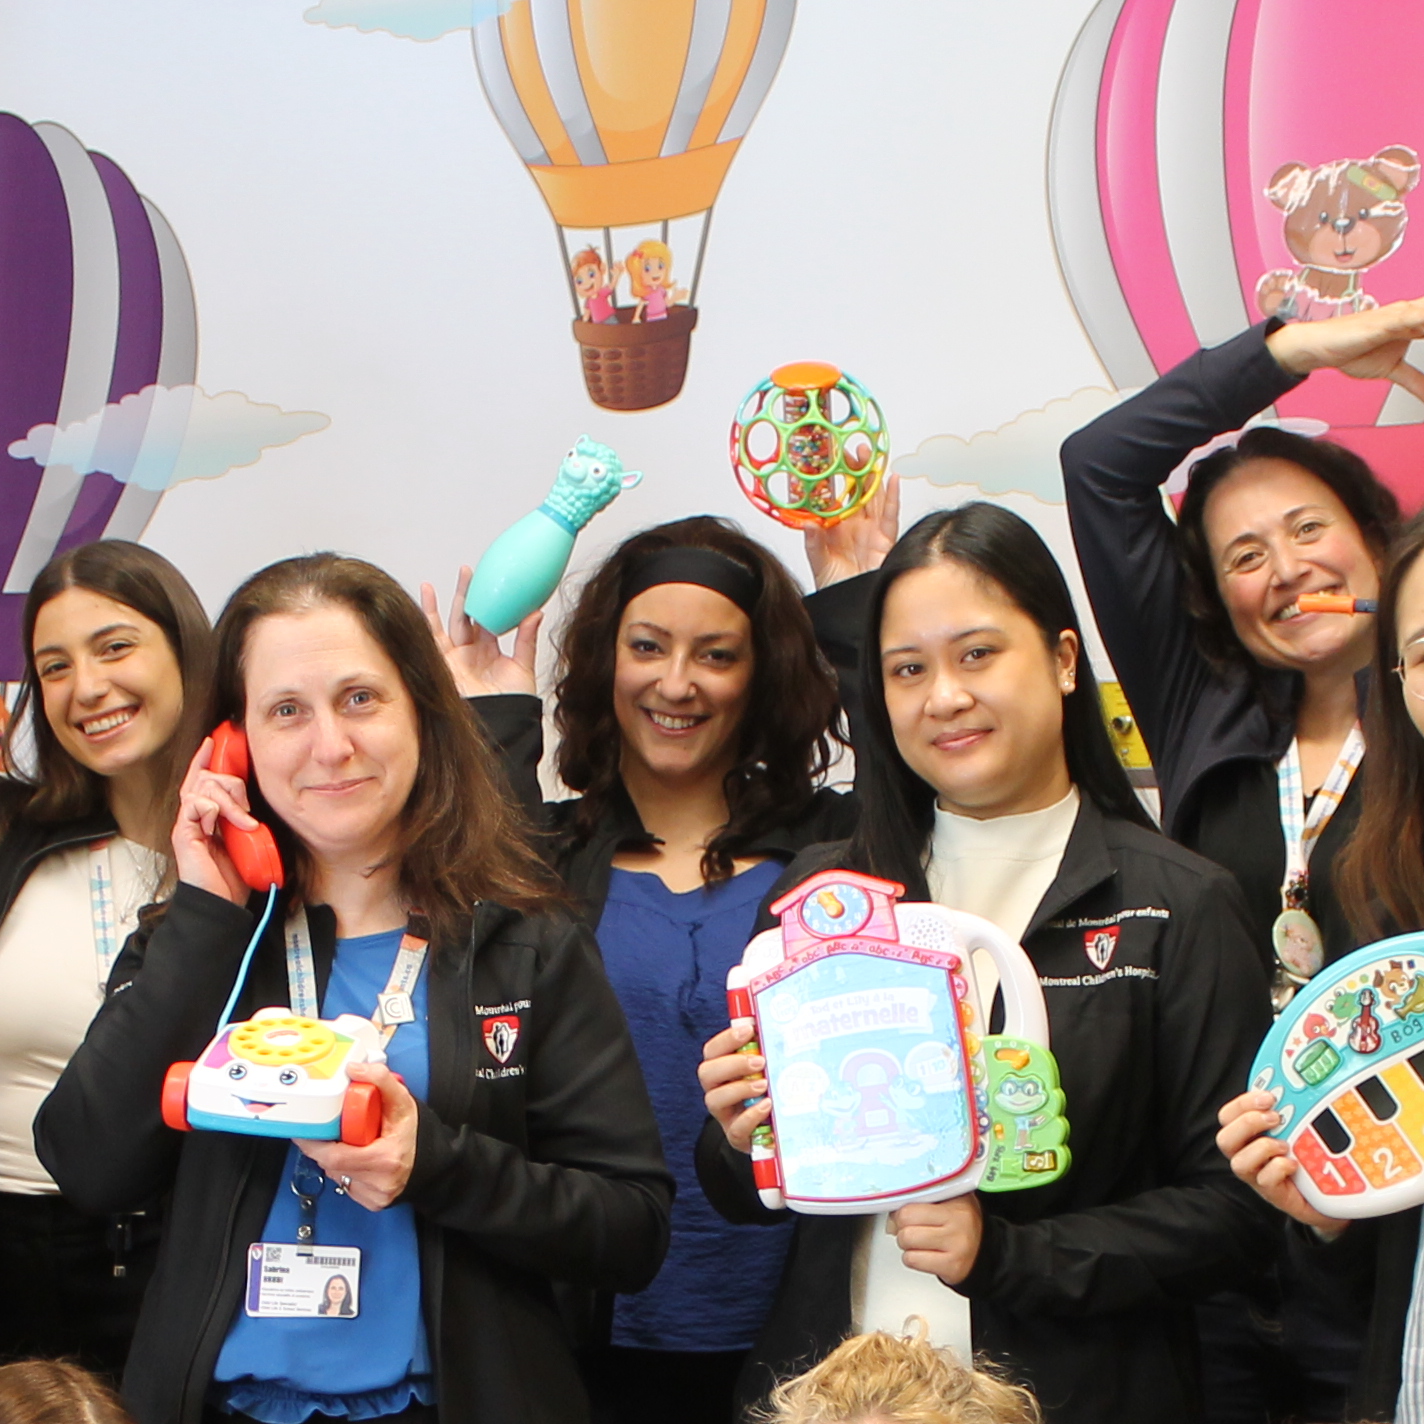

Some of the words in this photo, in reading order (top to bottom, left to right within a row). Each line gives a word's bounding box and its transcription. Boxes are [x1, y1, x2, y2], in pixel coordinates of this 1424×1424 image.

[792, 1002, 919, 1042] maternelle
[1322, 1160, 1347, 1189] 1
[1373, 1147, 1403, 1179] 2
